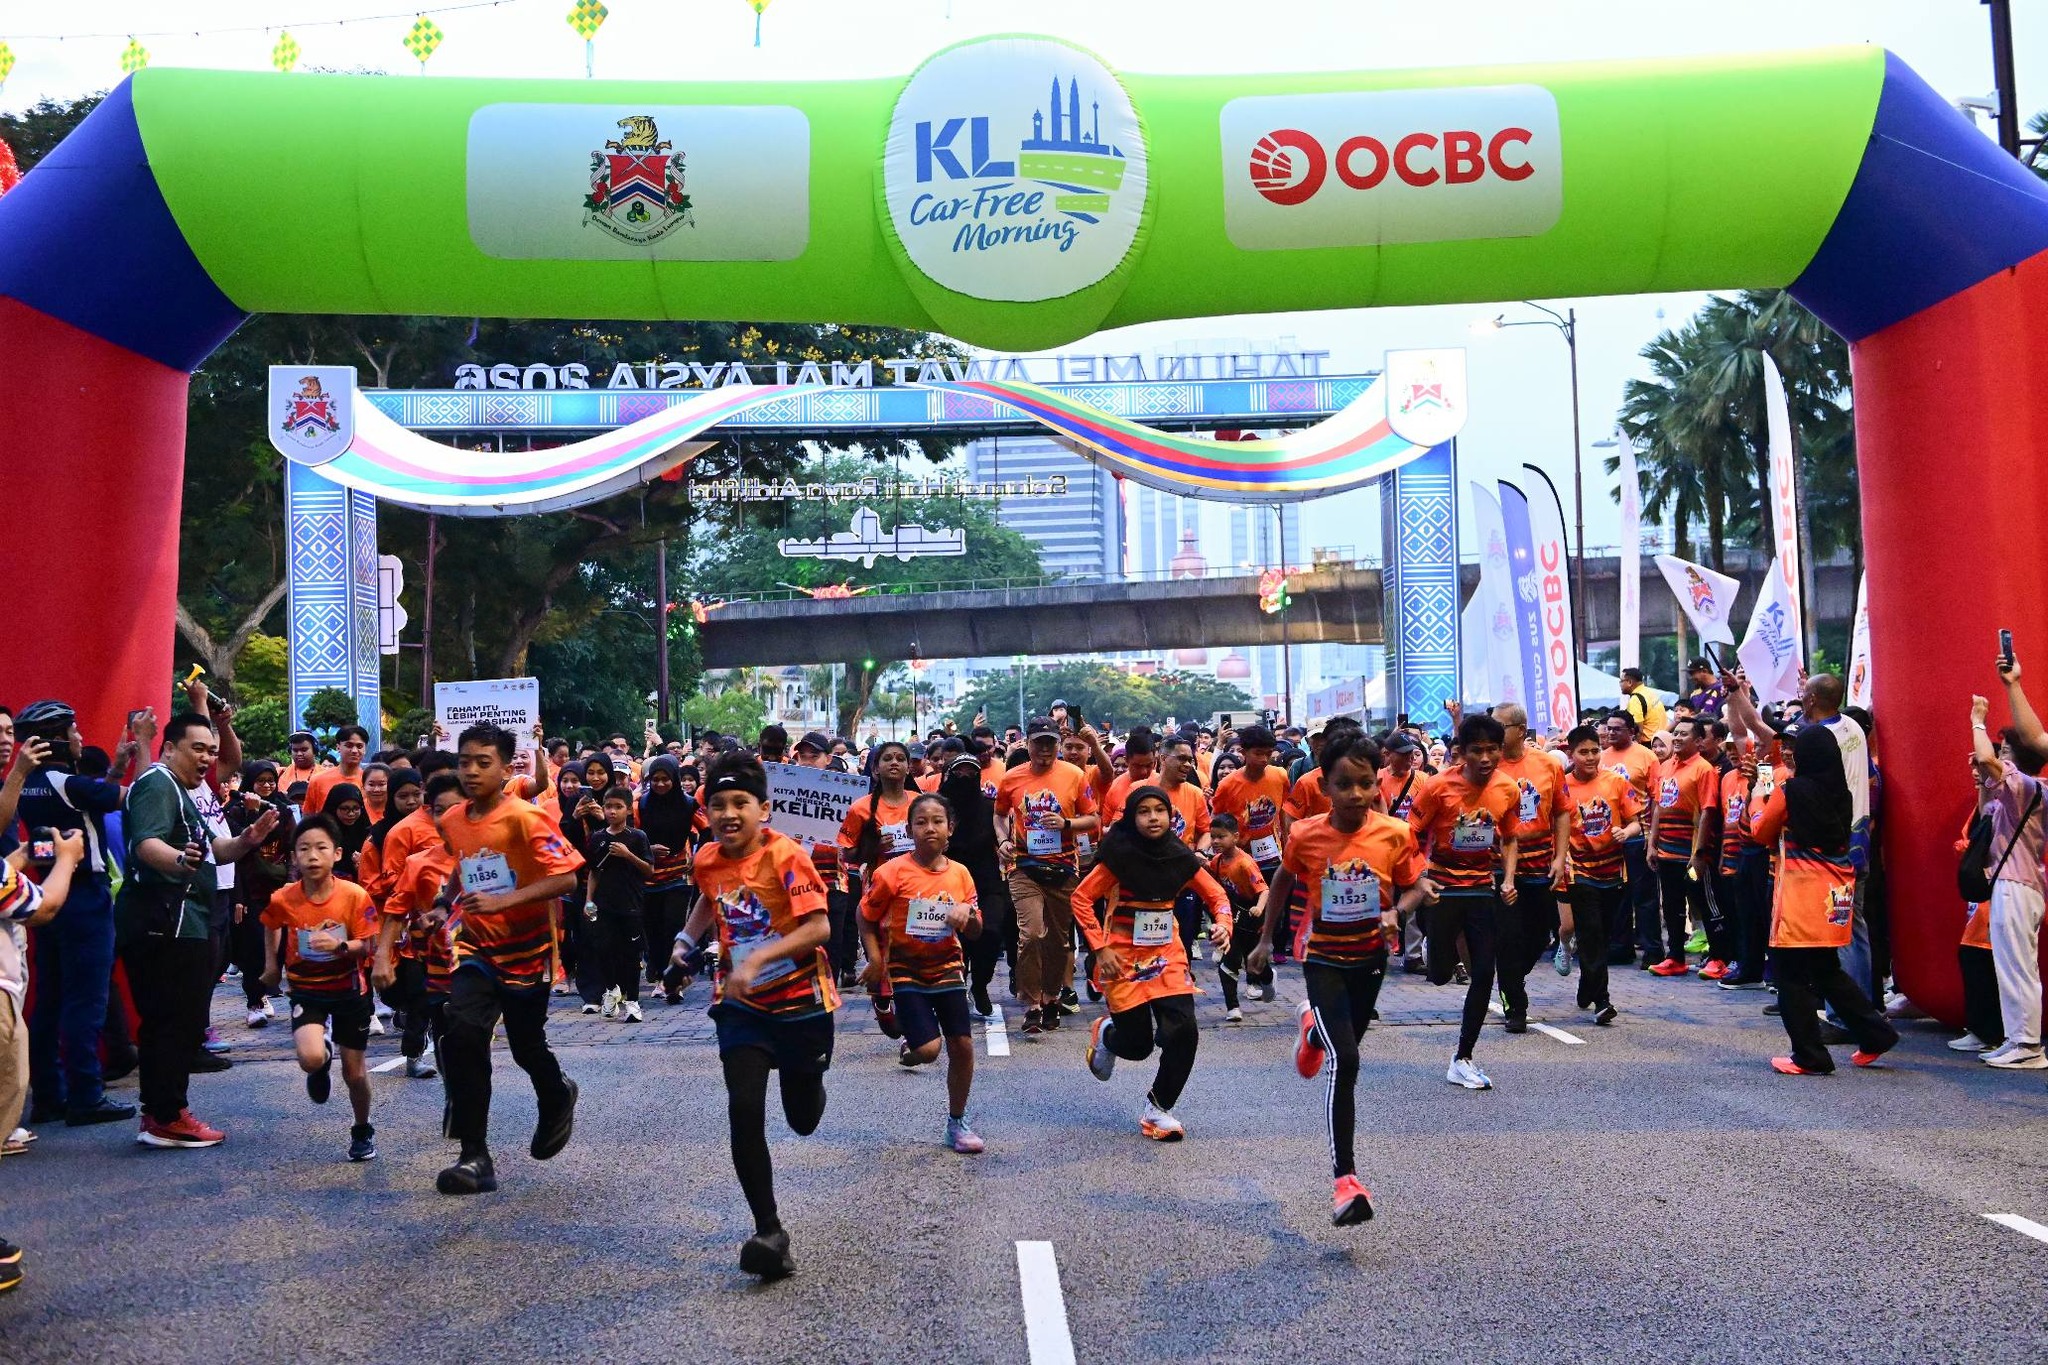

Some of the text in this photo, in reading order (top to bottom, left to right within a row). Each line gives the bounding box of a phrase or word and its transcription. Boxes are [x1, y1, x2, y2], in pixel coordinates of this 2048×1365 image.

[916, 117, 1015, 183] KL
[1335, 127, 1535, 190] OCBC
[910, 182, 1045, 226] Car-Free
[953, 218, 1080, 253] Morning
[1540, 540, 1568, 677] OCBC
[447, 704, 499, 713] FAHAM ITU
[447, 709, 526, 720] LEBIH PENTING
[773, 787, 853, 805] KITA MARAH
[795, 796, 831, 808] MEREKA
[772, 799, 849, 823] KELIRU
[467, 869, 499, 884] 31836
[1332, 893, 1368, 905] 31523
[916, 911, 946, 922] 31066
